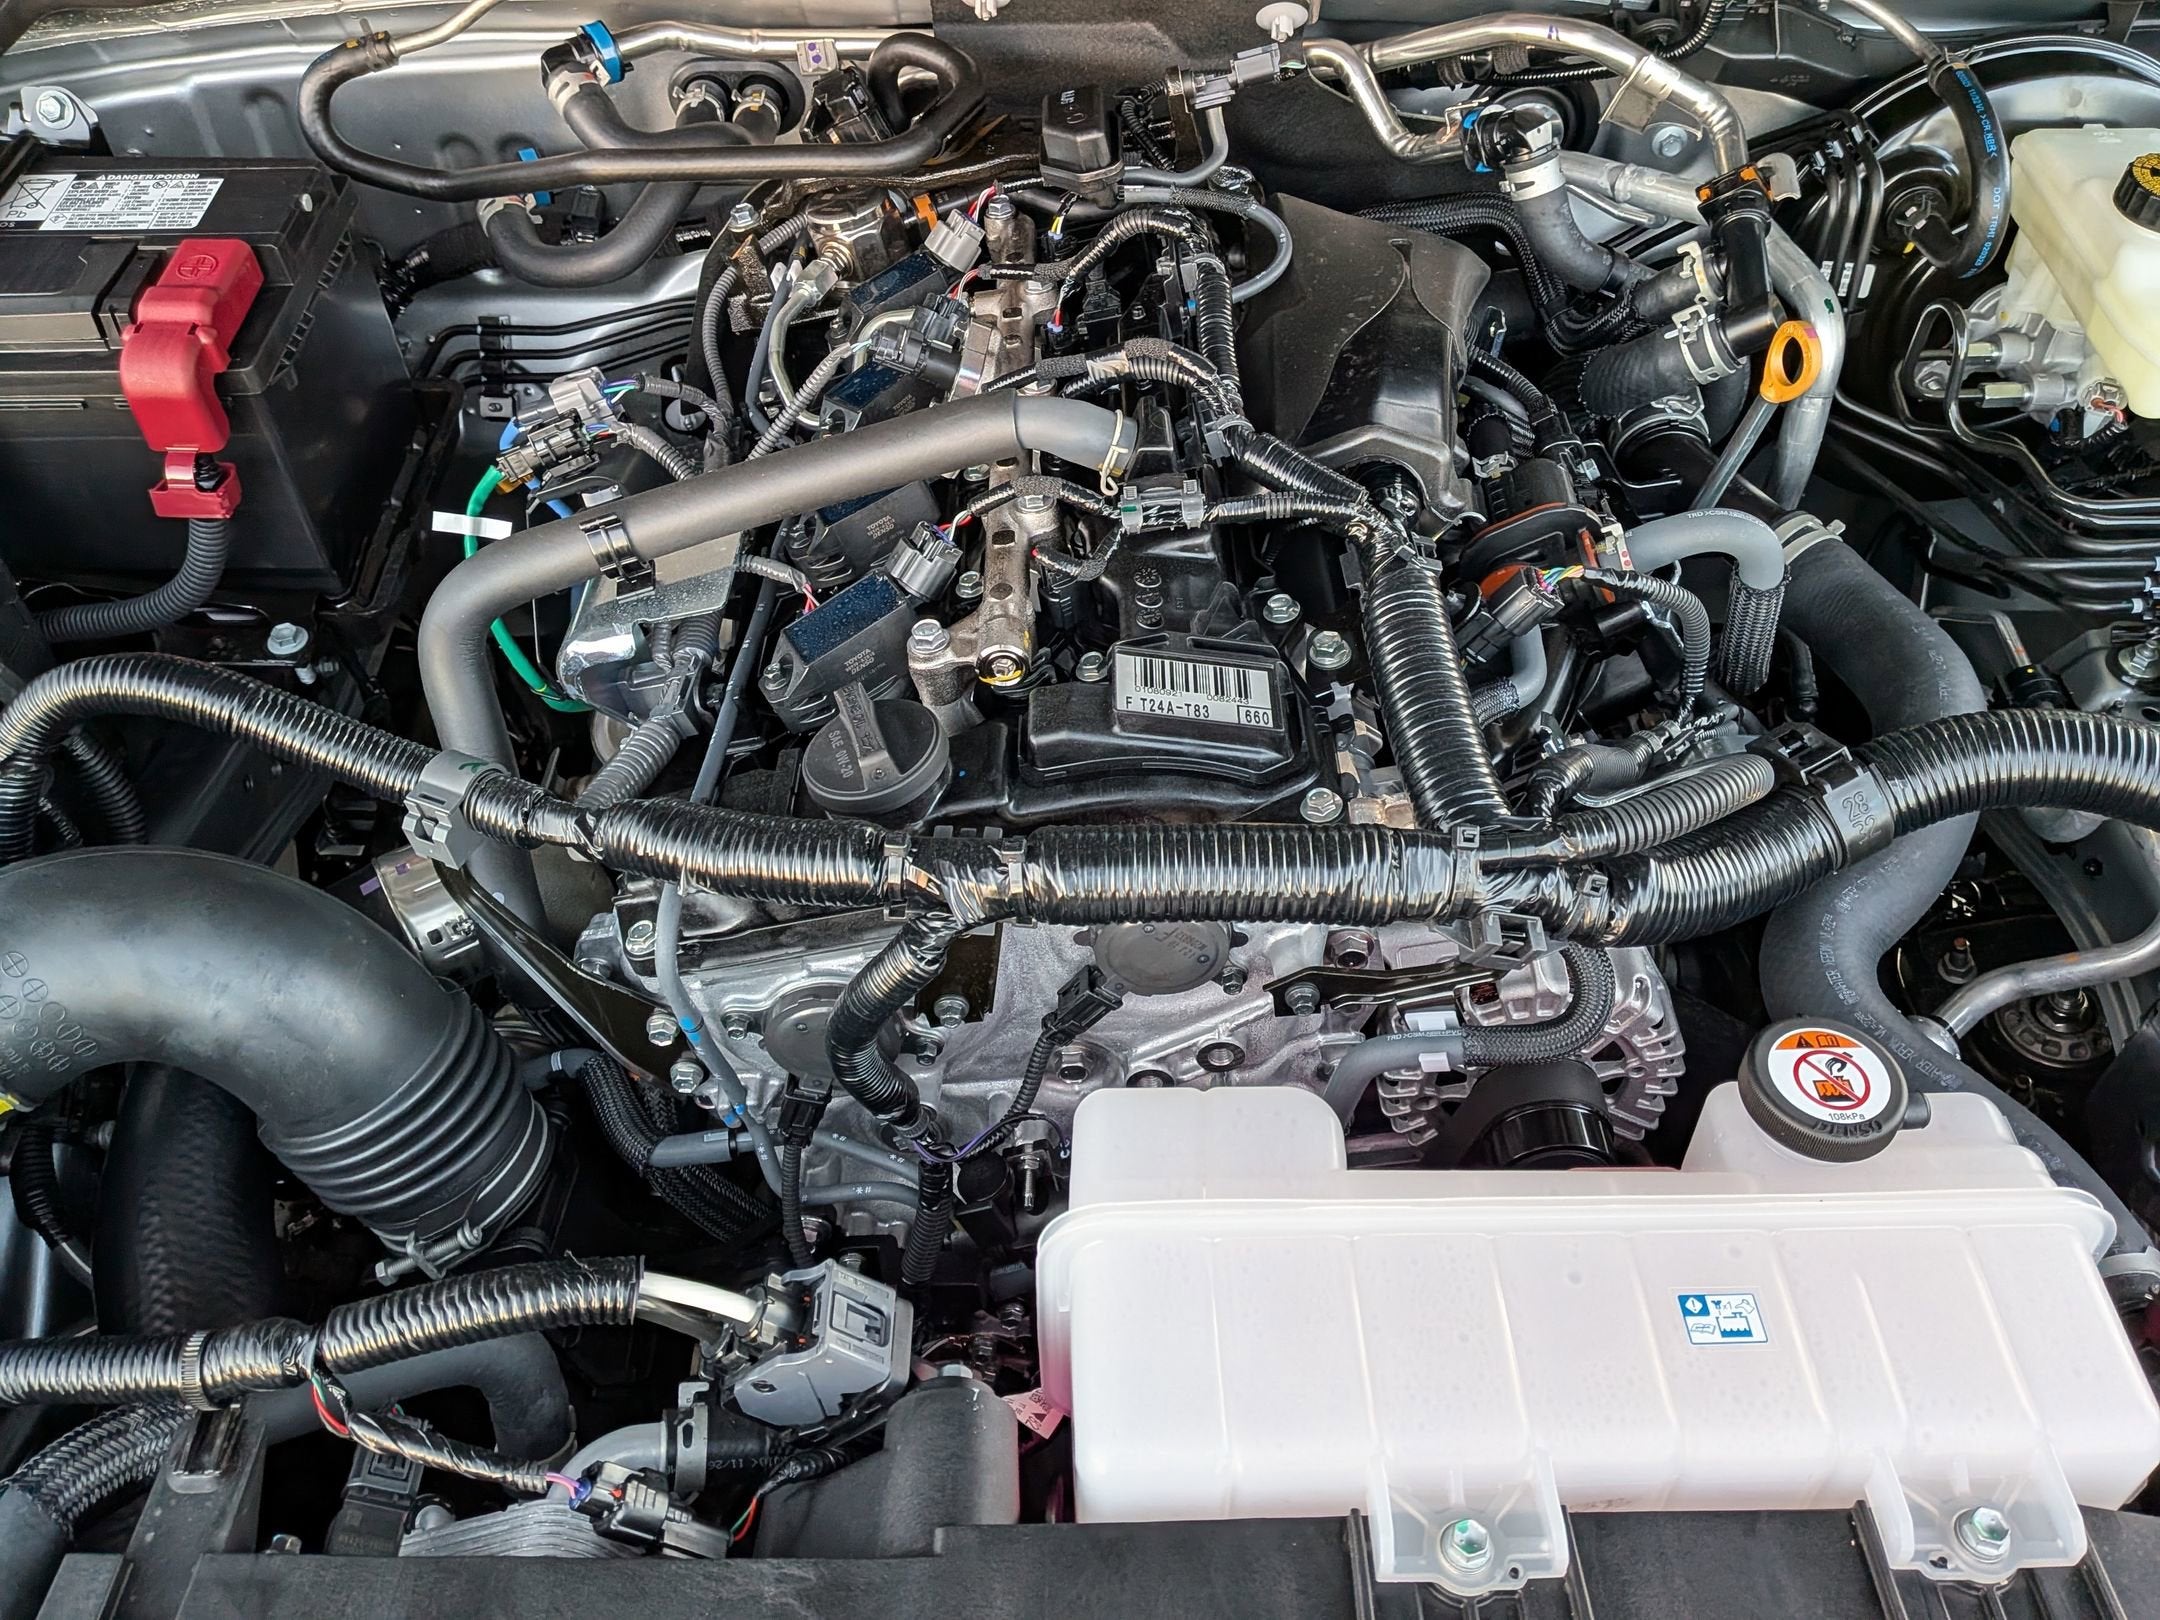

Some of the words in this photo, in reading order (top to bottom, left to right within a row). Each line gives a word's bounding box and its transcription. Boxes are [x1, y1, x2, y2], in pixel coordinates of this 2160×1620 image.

[106, 173, 200, 181] DANGER/POISON
[1993, 187, 2001, 209] DOT
[5, 211, 28, 219] Pb
[866, 515, 893, 531] TOYOTA
[873, 524, 895, 539] DENSO
[844, 648, 871, 666] TOYOTA
[851, 657, 875, 675] DENSO
[1135, 685, 1183, 698] 01080921
[1207, 694, 1250, 705] 0082443
[1126, 696, 1133, 709] F
[1140, 698, 1210, 718] T24A-T83
[1245, 709, 1270, 726] 660
[828, 730, 844, 749] SAE
[835, 750, 854, 778] 0W-20
[1842, 790, 1871, 822] 28
[1828, 1112, 1866, 1121] 108kPa
[1814, 1119, 1883, 1139] DENSO
